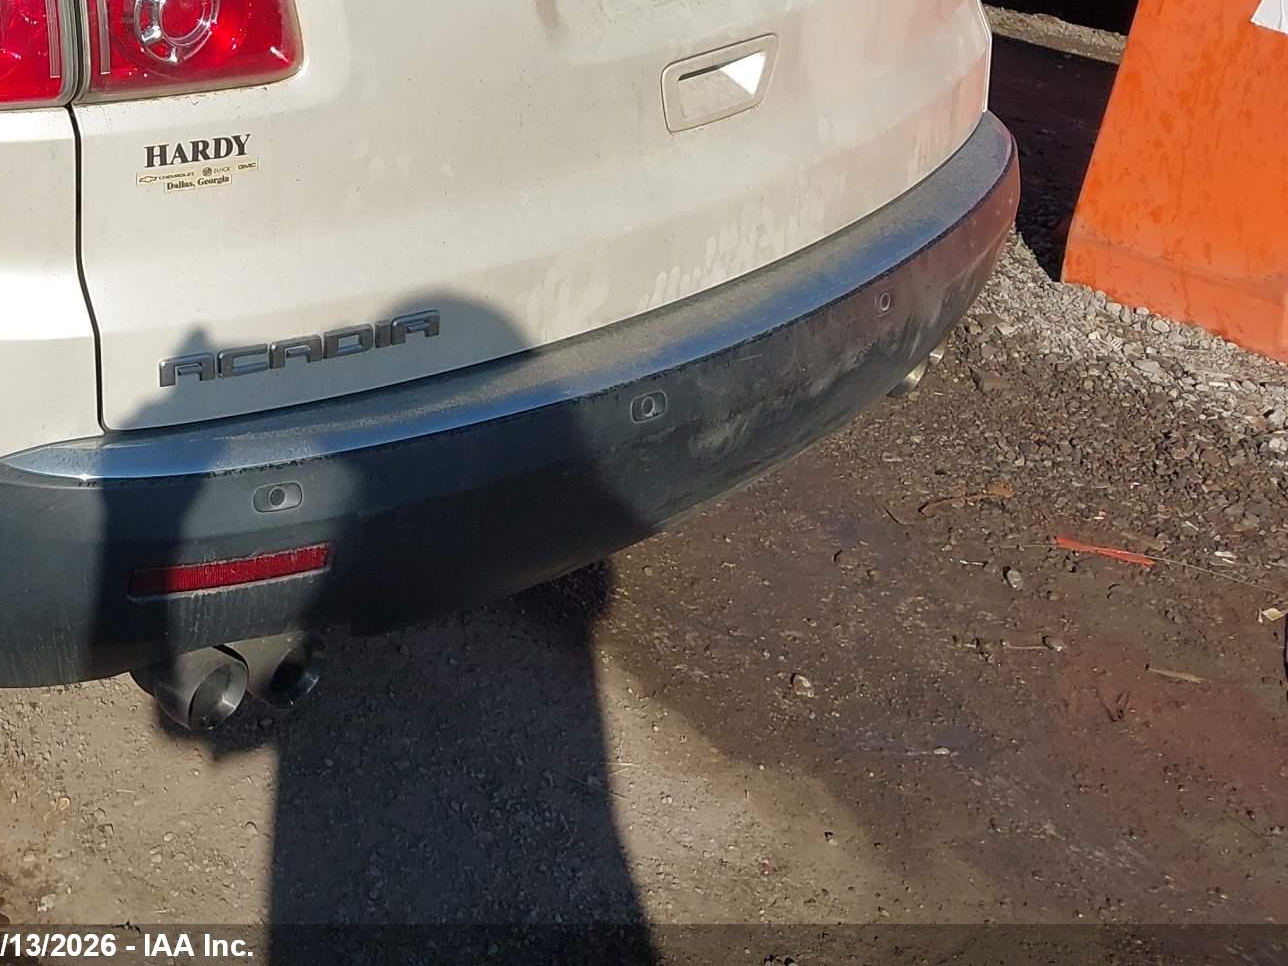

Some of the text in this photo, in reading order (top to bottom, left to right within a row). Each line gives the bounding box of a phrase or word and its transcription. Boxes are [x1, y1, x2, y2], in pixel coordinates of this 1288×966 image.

[144, 134, 251, 168] HARDY
[167, 174, 230, 190] Dallas, Georgia
[158, 309, 441, 388] ACADIA
